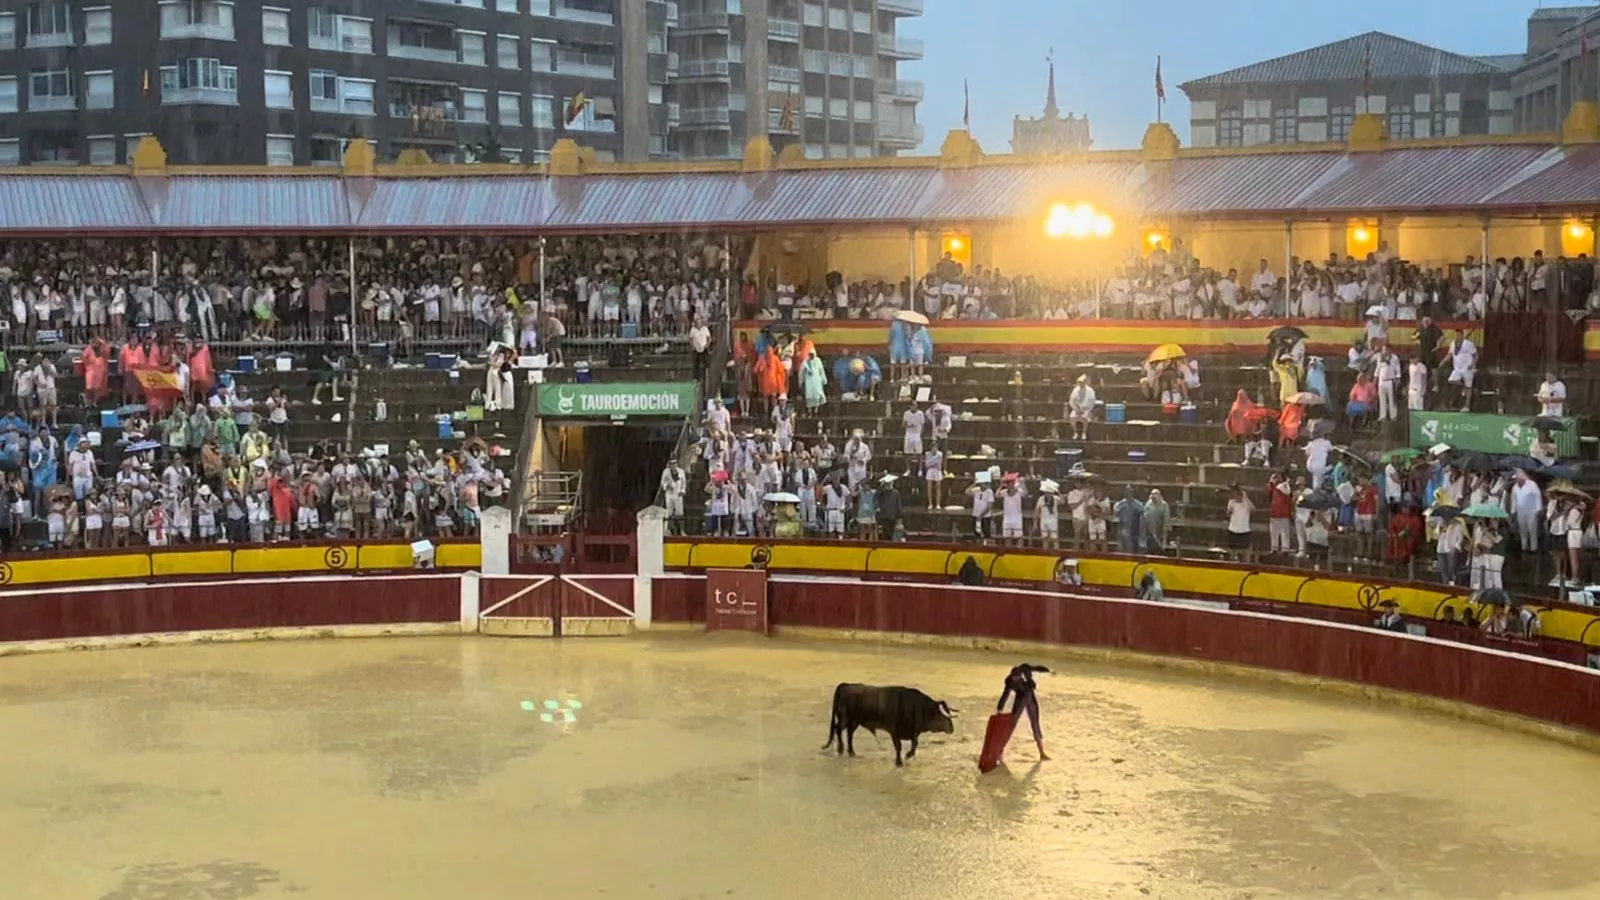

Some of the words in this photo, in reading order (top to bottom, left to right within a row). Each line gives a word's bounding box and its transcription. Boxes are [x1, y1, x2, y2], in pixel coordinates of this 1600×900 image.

[580, 391, 679, 410] TAUROEMOCIÓN
[1442, 432, 1453, 441] TV
[331, 550, 341, 565] 5
